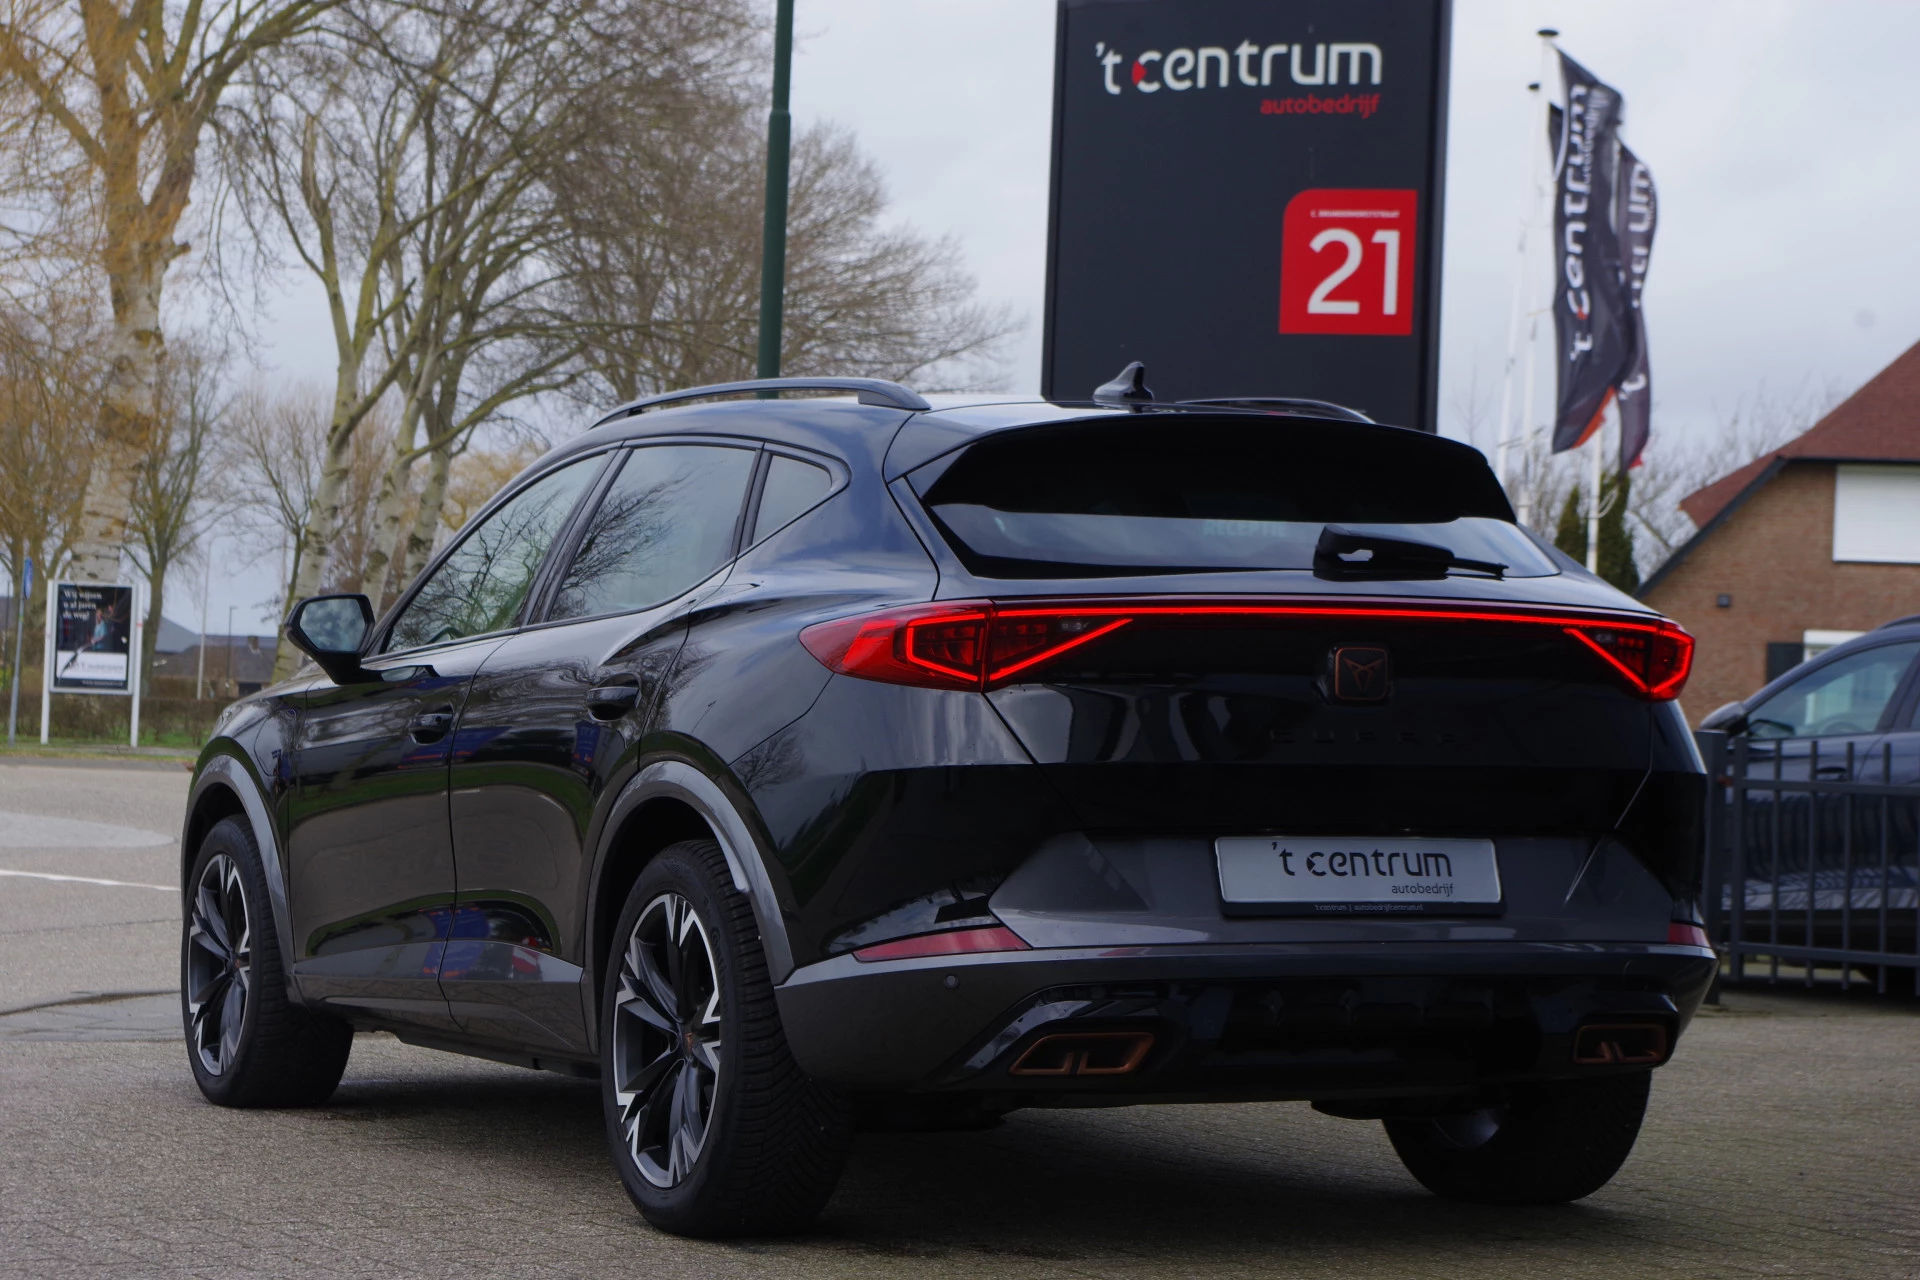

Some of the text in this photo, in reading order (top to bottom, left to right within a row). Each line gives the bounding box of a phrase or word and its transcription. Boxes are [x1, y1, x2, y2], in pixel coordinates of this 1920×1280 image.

[1132, 39, 1382, 93] centrum
[1260, 94, 1382, 118] autobedrijf
[1564, 84, 1590, 320] centrum
[1307, 227, 1400, 315] 21
[1306, 848, 1453, 877] centrum
[1391, 882, 1454, 896] autobedrijf
